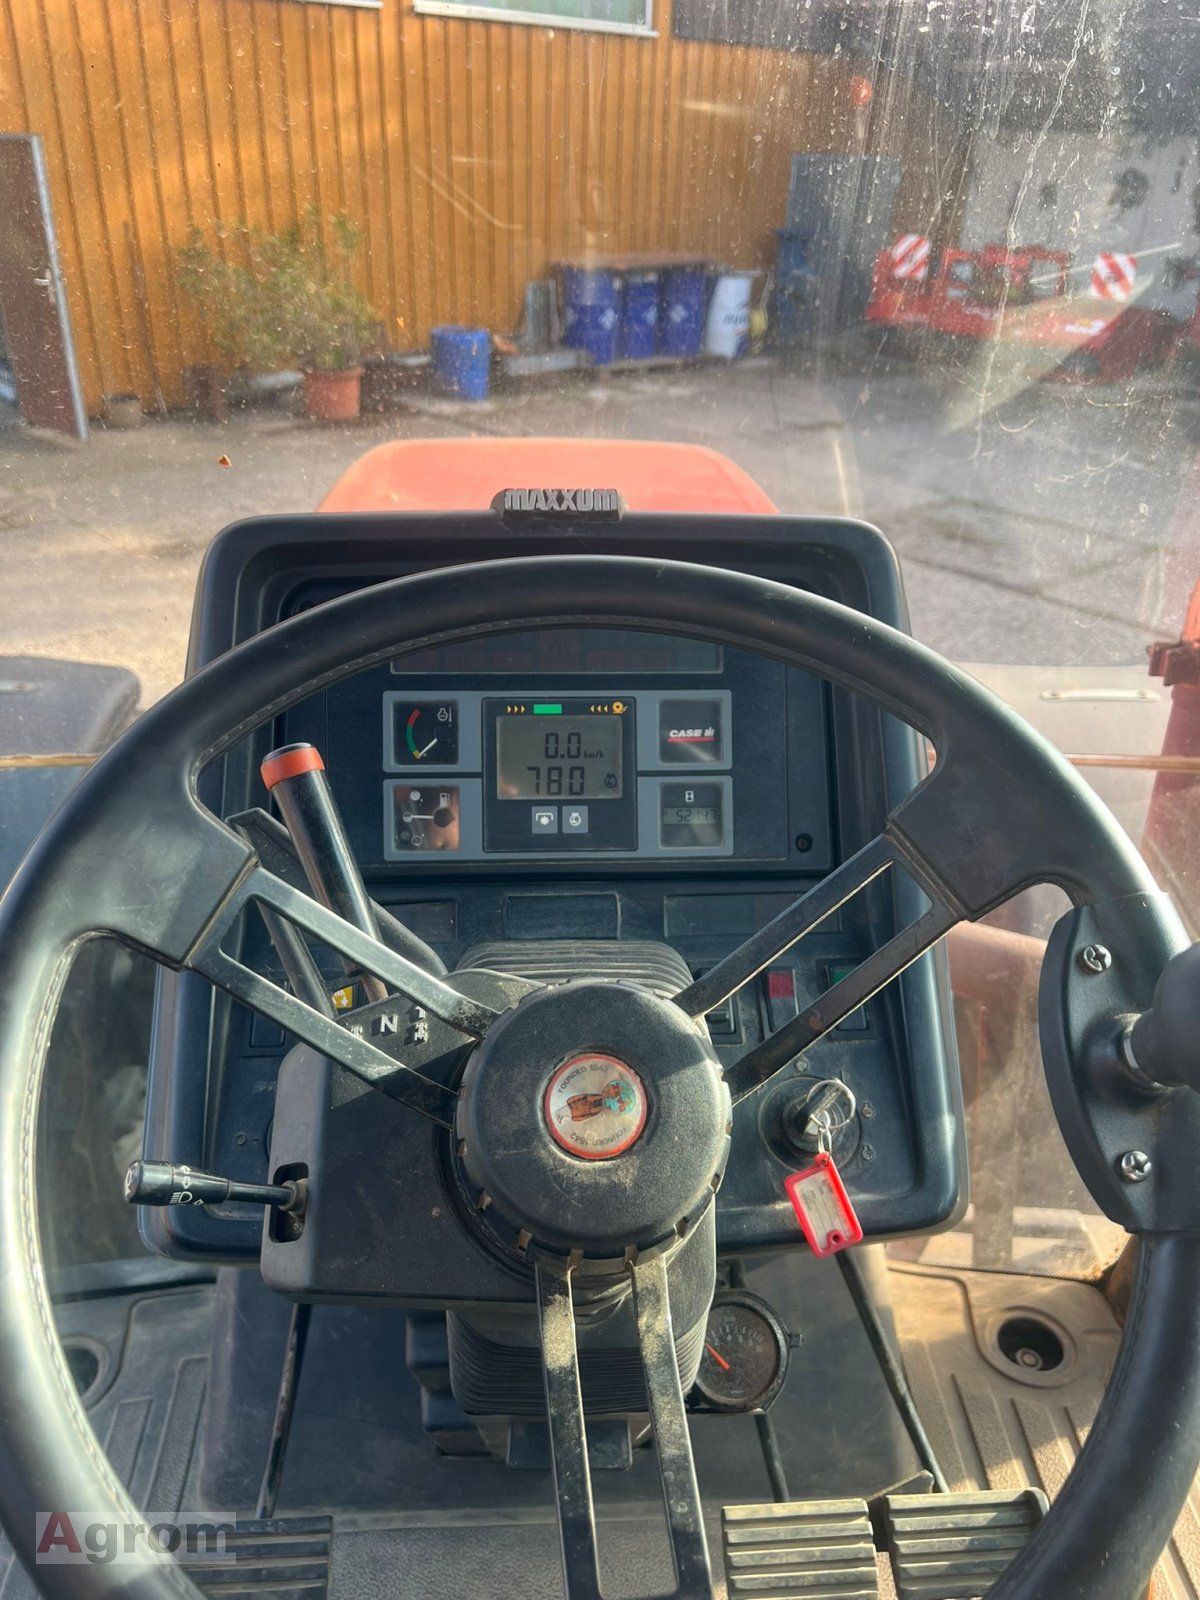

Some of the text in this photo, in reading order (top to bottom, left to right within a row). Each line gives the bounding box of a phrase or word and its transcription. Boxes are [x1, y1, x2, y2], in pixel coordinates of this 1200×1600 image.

[504, 489, 618, 511] MAXXUM
[669, 729, 703, 738] CASE
[545, 732, 604, 759] 0.0 km/h
[527, 766, 585, 795] 780
[380, 1014, 398, 1033] N
